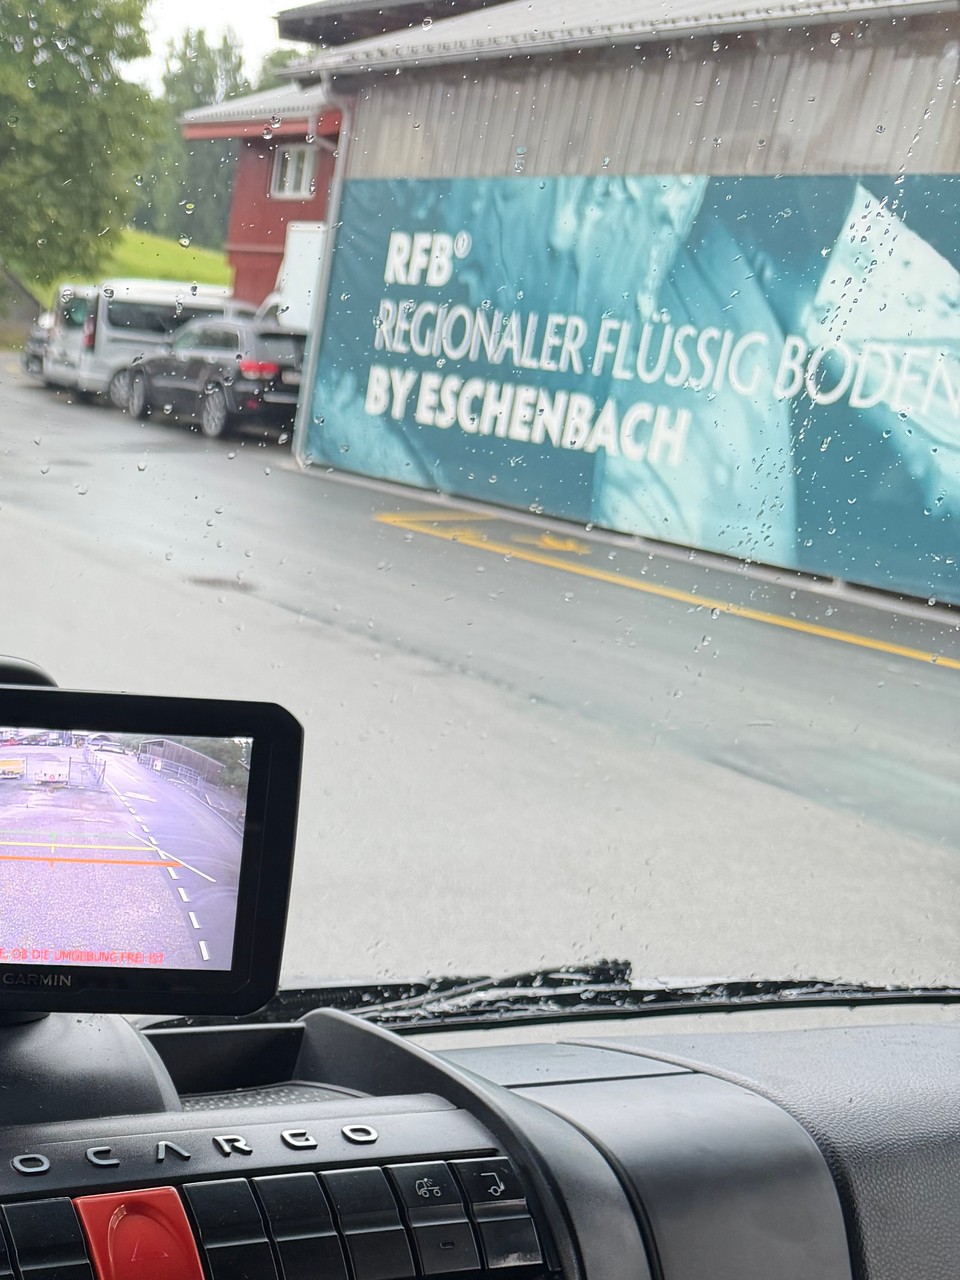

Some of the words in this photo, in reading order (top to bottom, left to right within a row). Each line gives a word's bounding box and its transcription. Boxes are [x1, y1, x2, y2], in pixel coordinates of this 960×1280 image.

[373, 298, 587, 375] REGIONALER
[592, 308, 768, 396] FLÜSSIG
[364, 364, 418, 420] BY
[414, 372, 693, 466] ESCHENBACH
[2, 972, 72, 987] GARMIN
